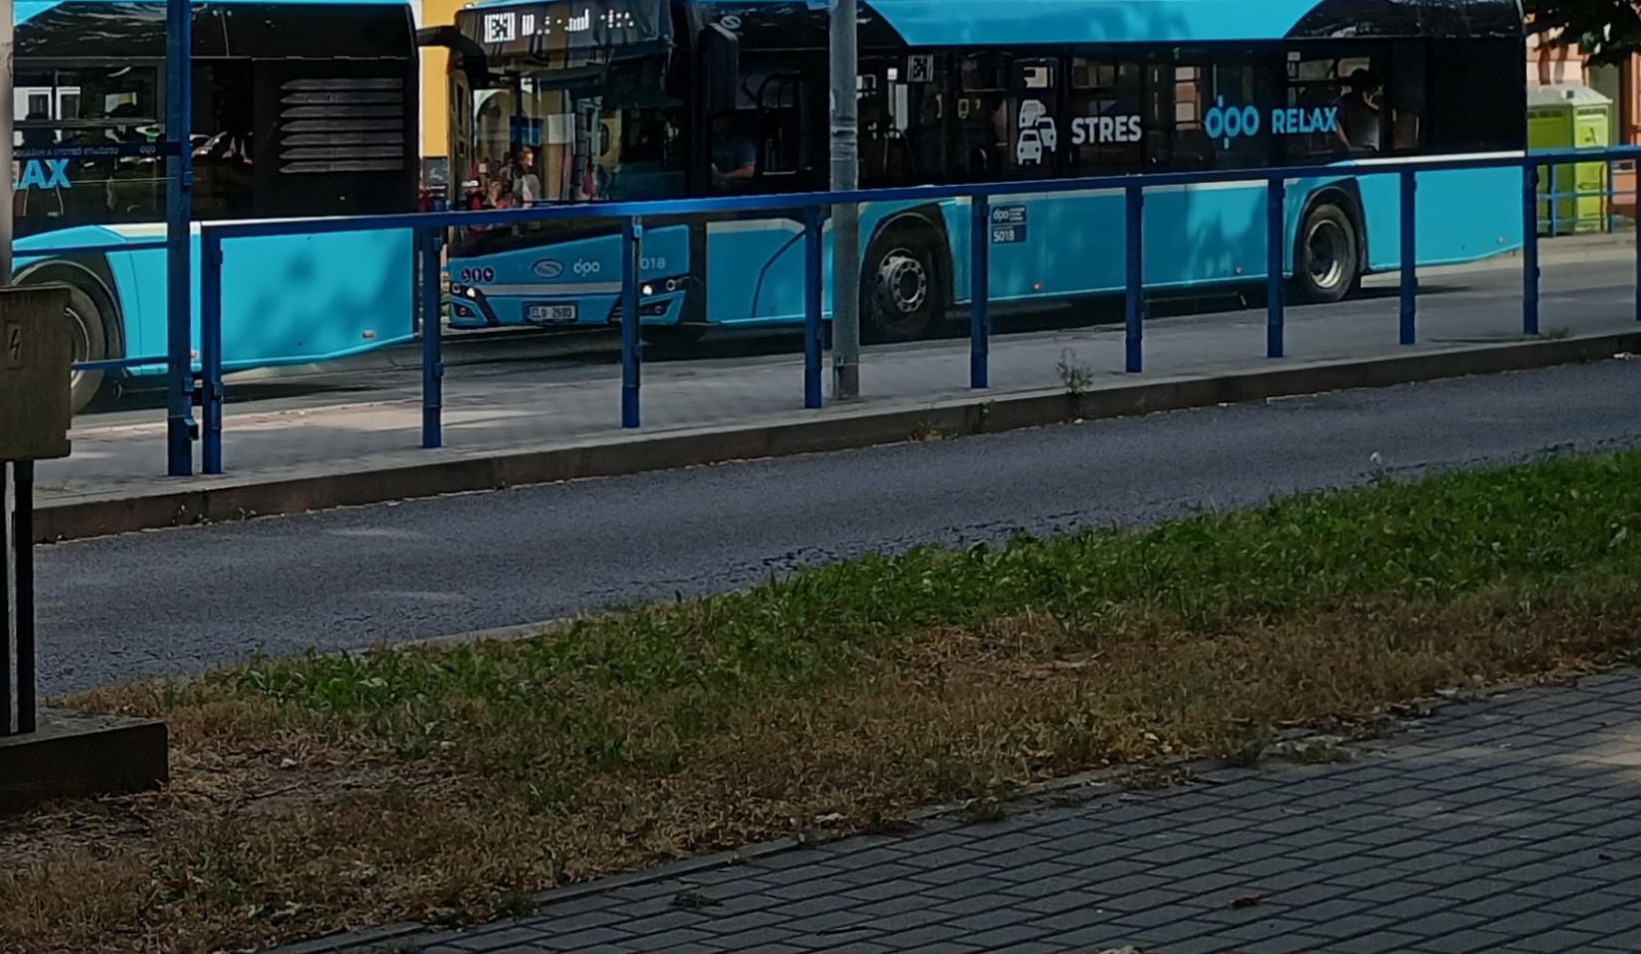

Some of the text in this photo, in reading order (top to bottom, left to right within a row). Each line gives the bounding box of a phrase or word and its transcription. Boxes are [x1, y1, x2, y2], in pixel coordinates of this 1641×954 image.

[1071, 115, 1142, 144] STRES
[1272, 106, 1338, 134] RELAX
[639, 257, 666, 270] 018
